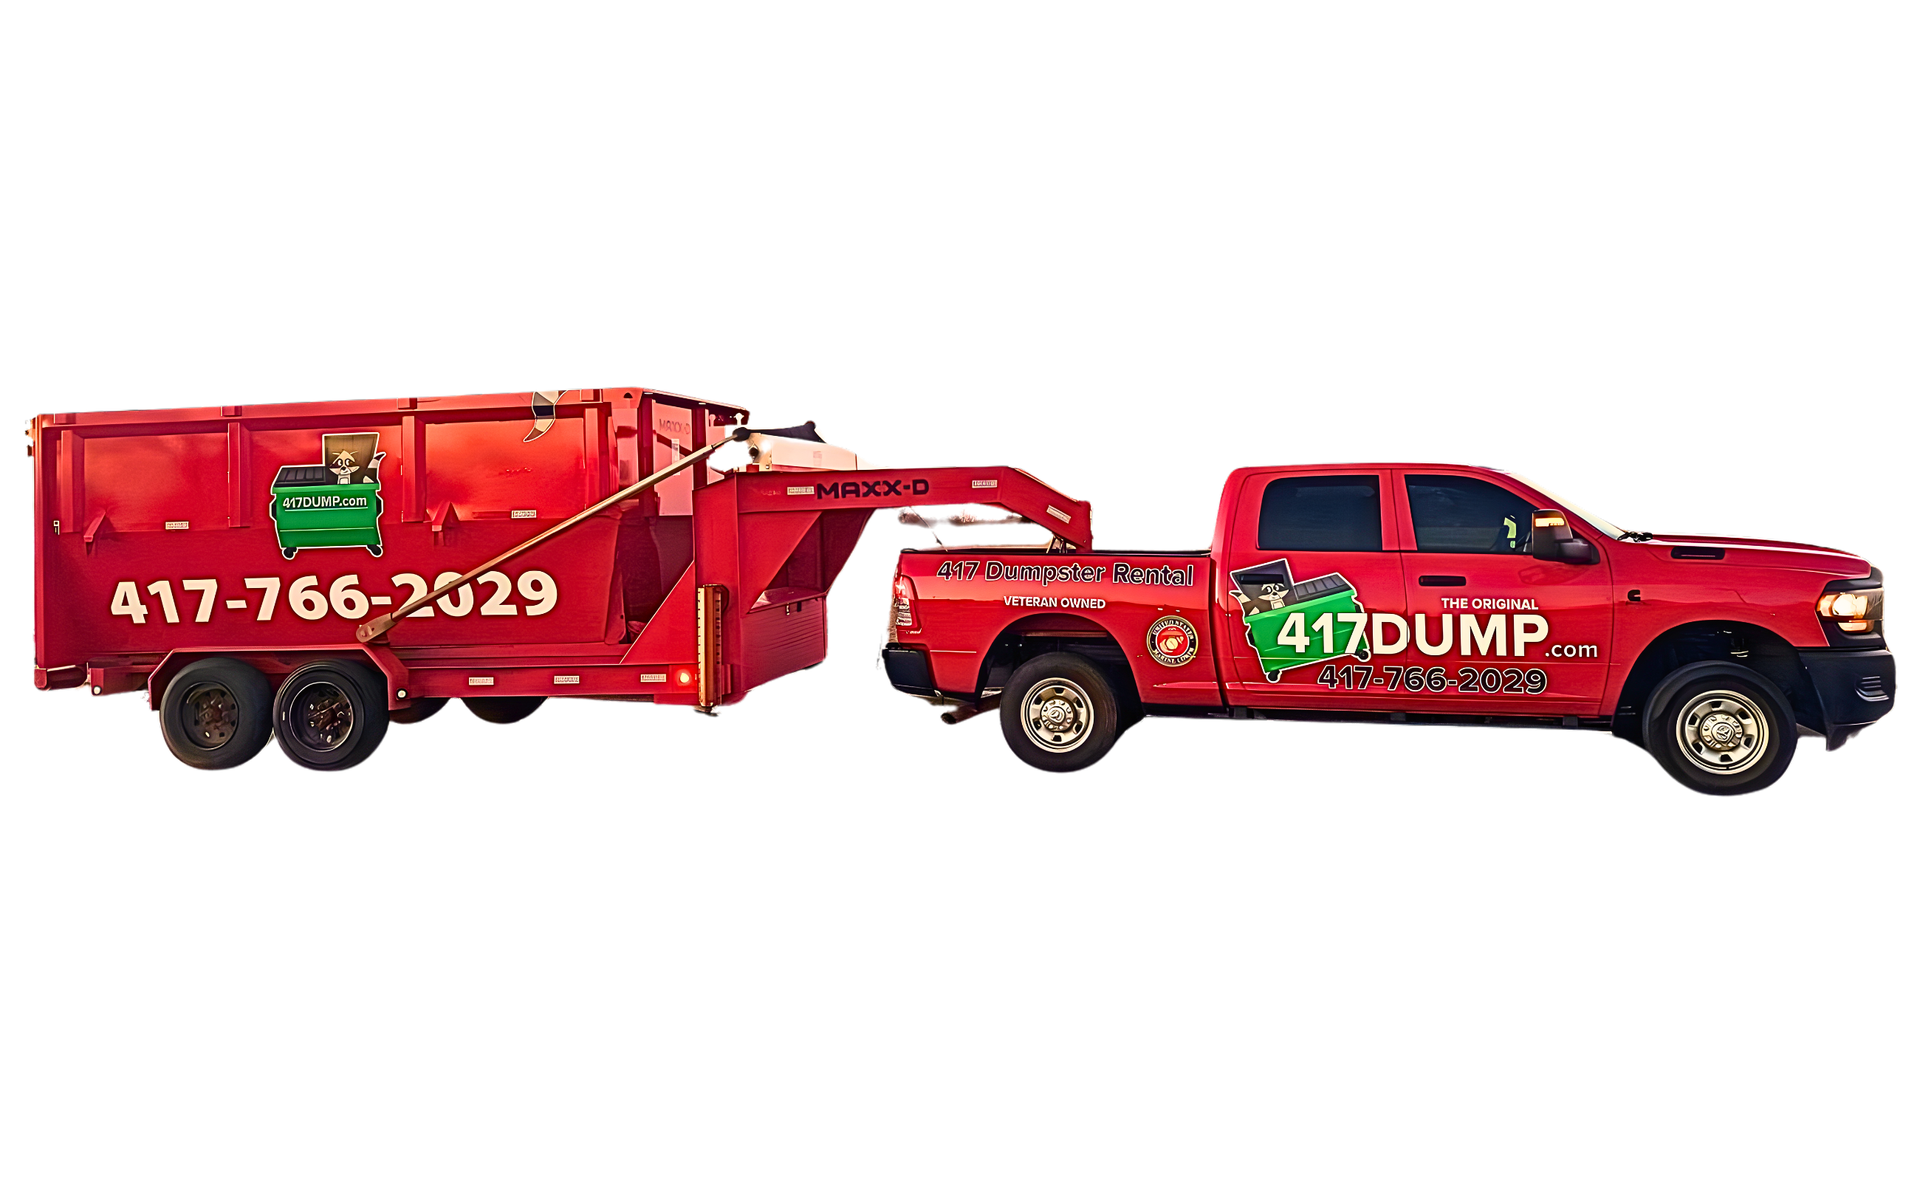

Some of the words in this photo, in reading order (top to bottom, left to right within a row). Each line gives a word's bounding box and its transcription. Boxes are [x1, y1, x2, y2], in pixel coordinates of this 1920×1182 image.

[816, 478, 930, 500] MAXX-D
[282, 495, 367, 508] 417DUMP.com
[936, 560, 980, 581] 417
[985, 561, 1106, 586] Dumpster
[1112, 562, 1194, 586] Rental
[110, 570, 558, 624] 417-766-2029
[1003, 595, 1058, 608] VETERAN
[1060, 597, 1106, 609] OWNED
[1441, 597, 1469, 609] THE
[1472, 598, 1539, 610] ORIGINAL
[1318, 665, 1548, 695] 417-766-2029
